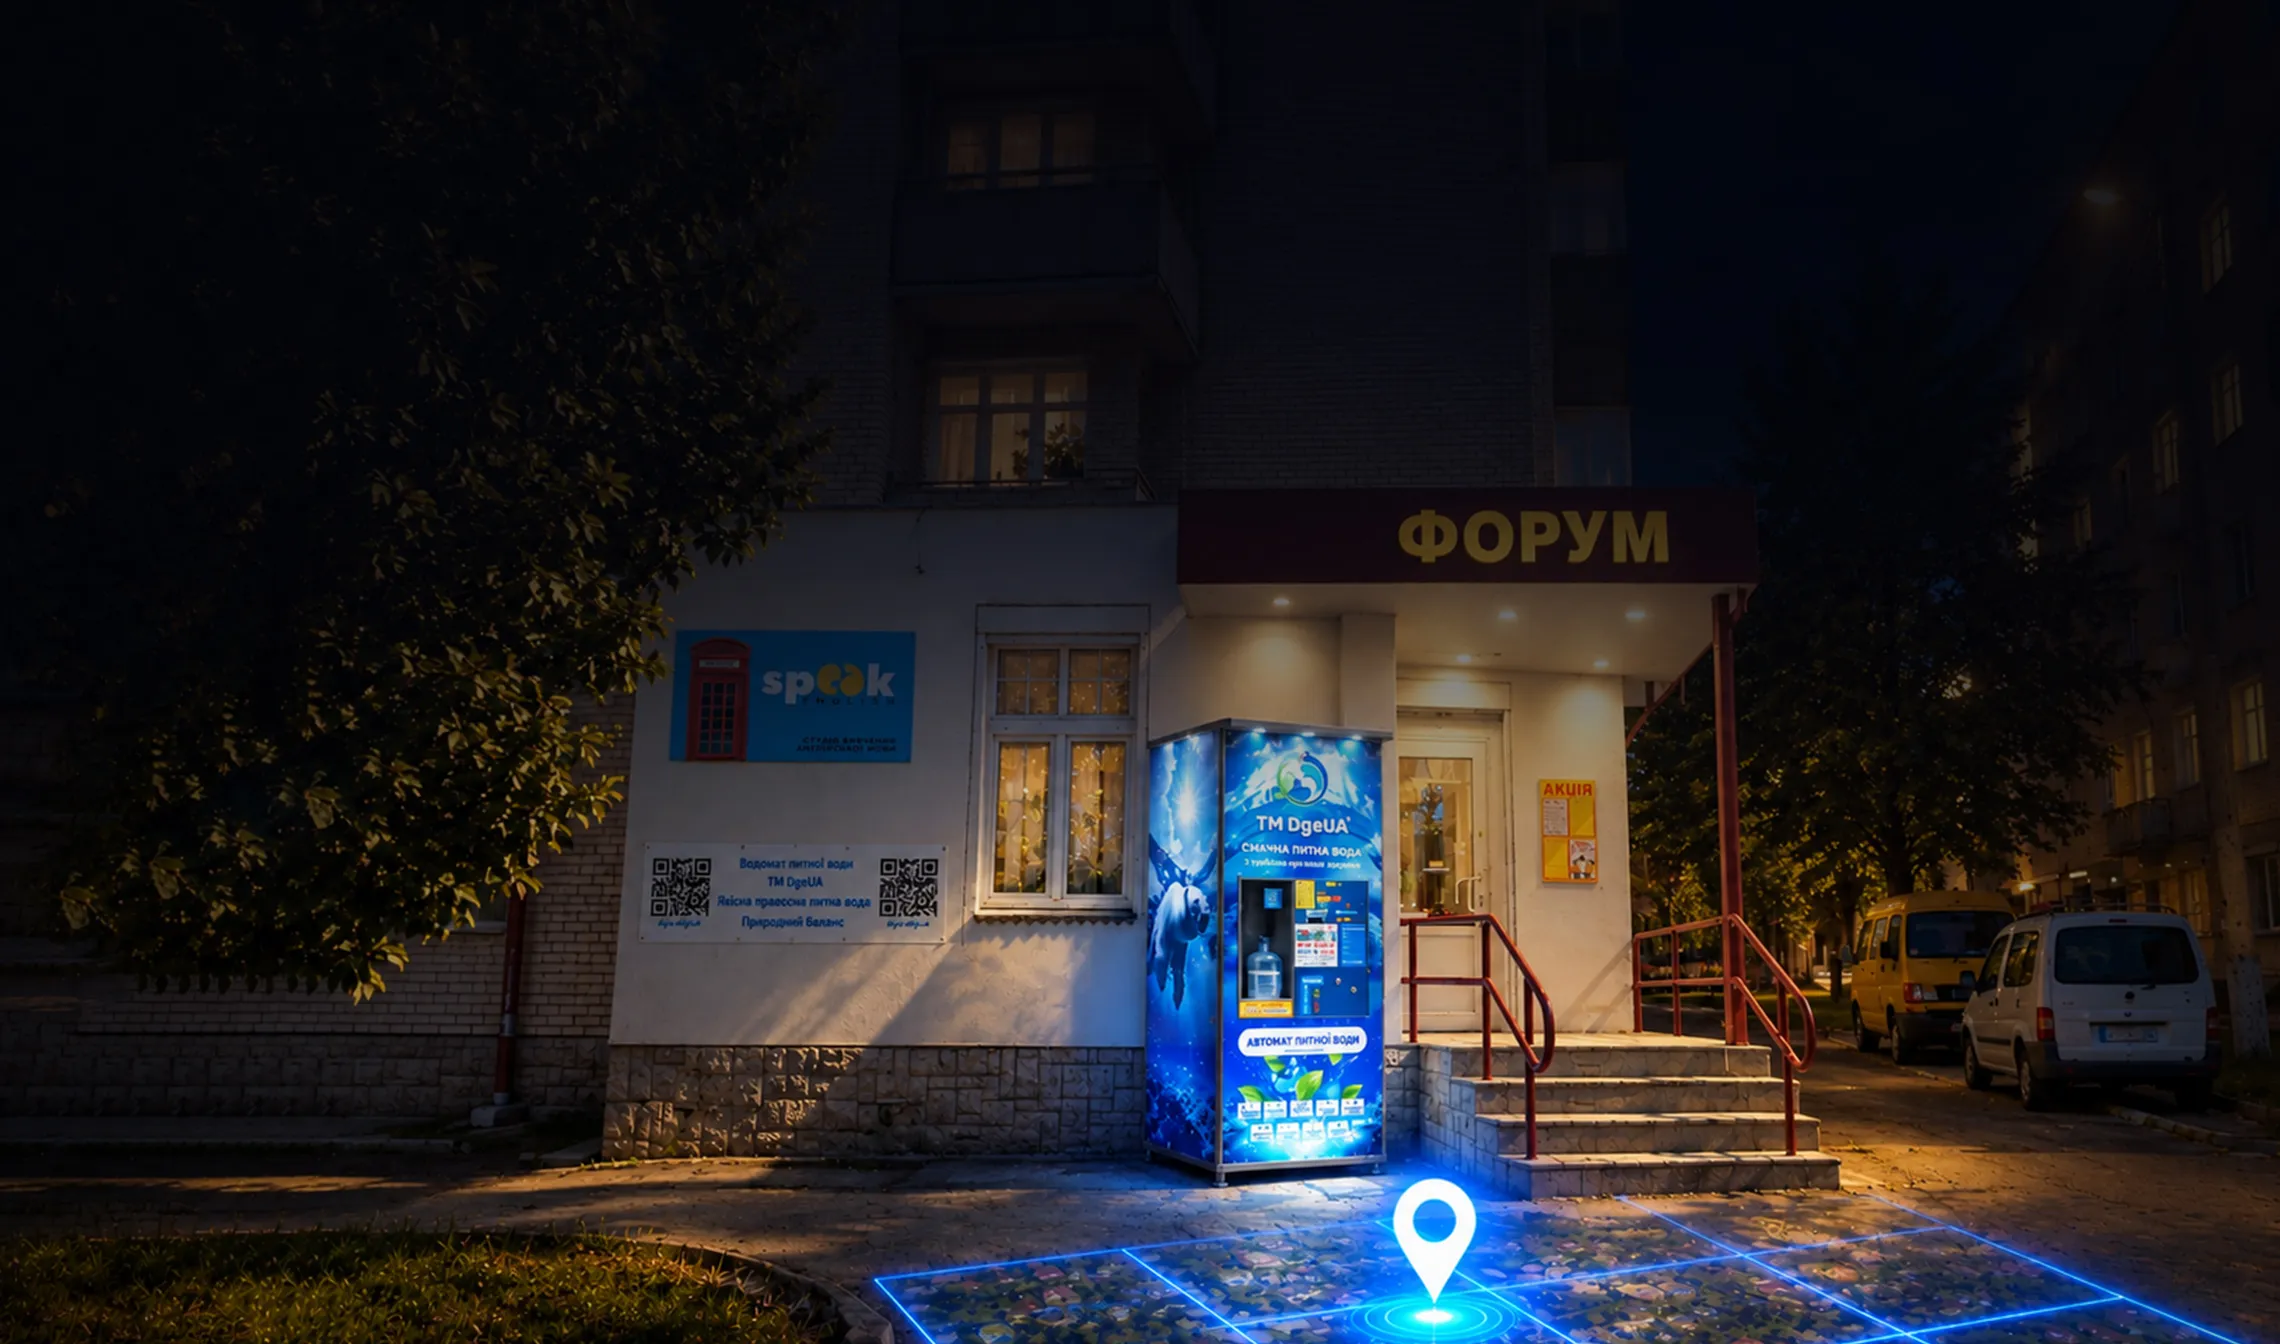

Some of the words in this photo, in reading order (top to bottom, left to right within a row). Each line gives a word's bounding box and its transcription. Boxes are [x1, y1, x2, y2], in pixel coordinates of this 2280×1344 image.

[1398, 509, 1669, 564] ФОРУМ
[761, 663, 896, 705] speak
[1241, 843, 1289, 855] СМАЧНА
[1292, 845, 1330, 856] ПИТНА
[1332, 847, 1362, 858] ВОДА
[739, 858, 786, 870] Водомат
[789, 857, 824, 869] питної
[827, 860, 854, 870] води
[717, 895, 752, 907] Якісна
[810, 898, 842, 907] питна
[845, 898, 872, 908] вода
[741, 916, 803, 929] Природний
[1246, 1036, 1293, 1048] АВТОМАТ
[1295, 1032, 1331, 1046] ПИТНОЇ
[1333, 1035, 1360, 1047] ВОДИ
